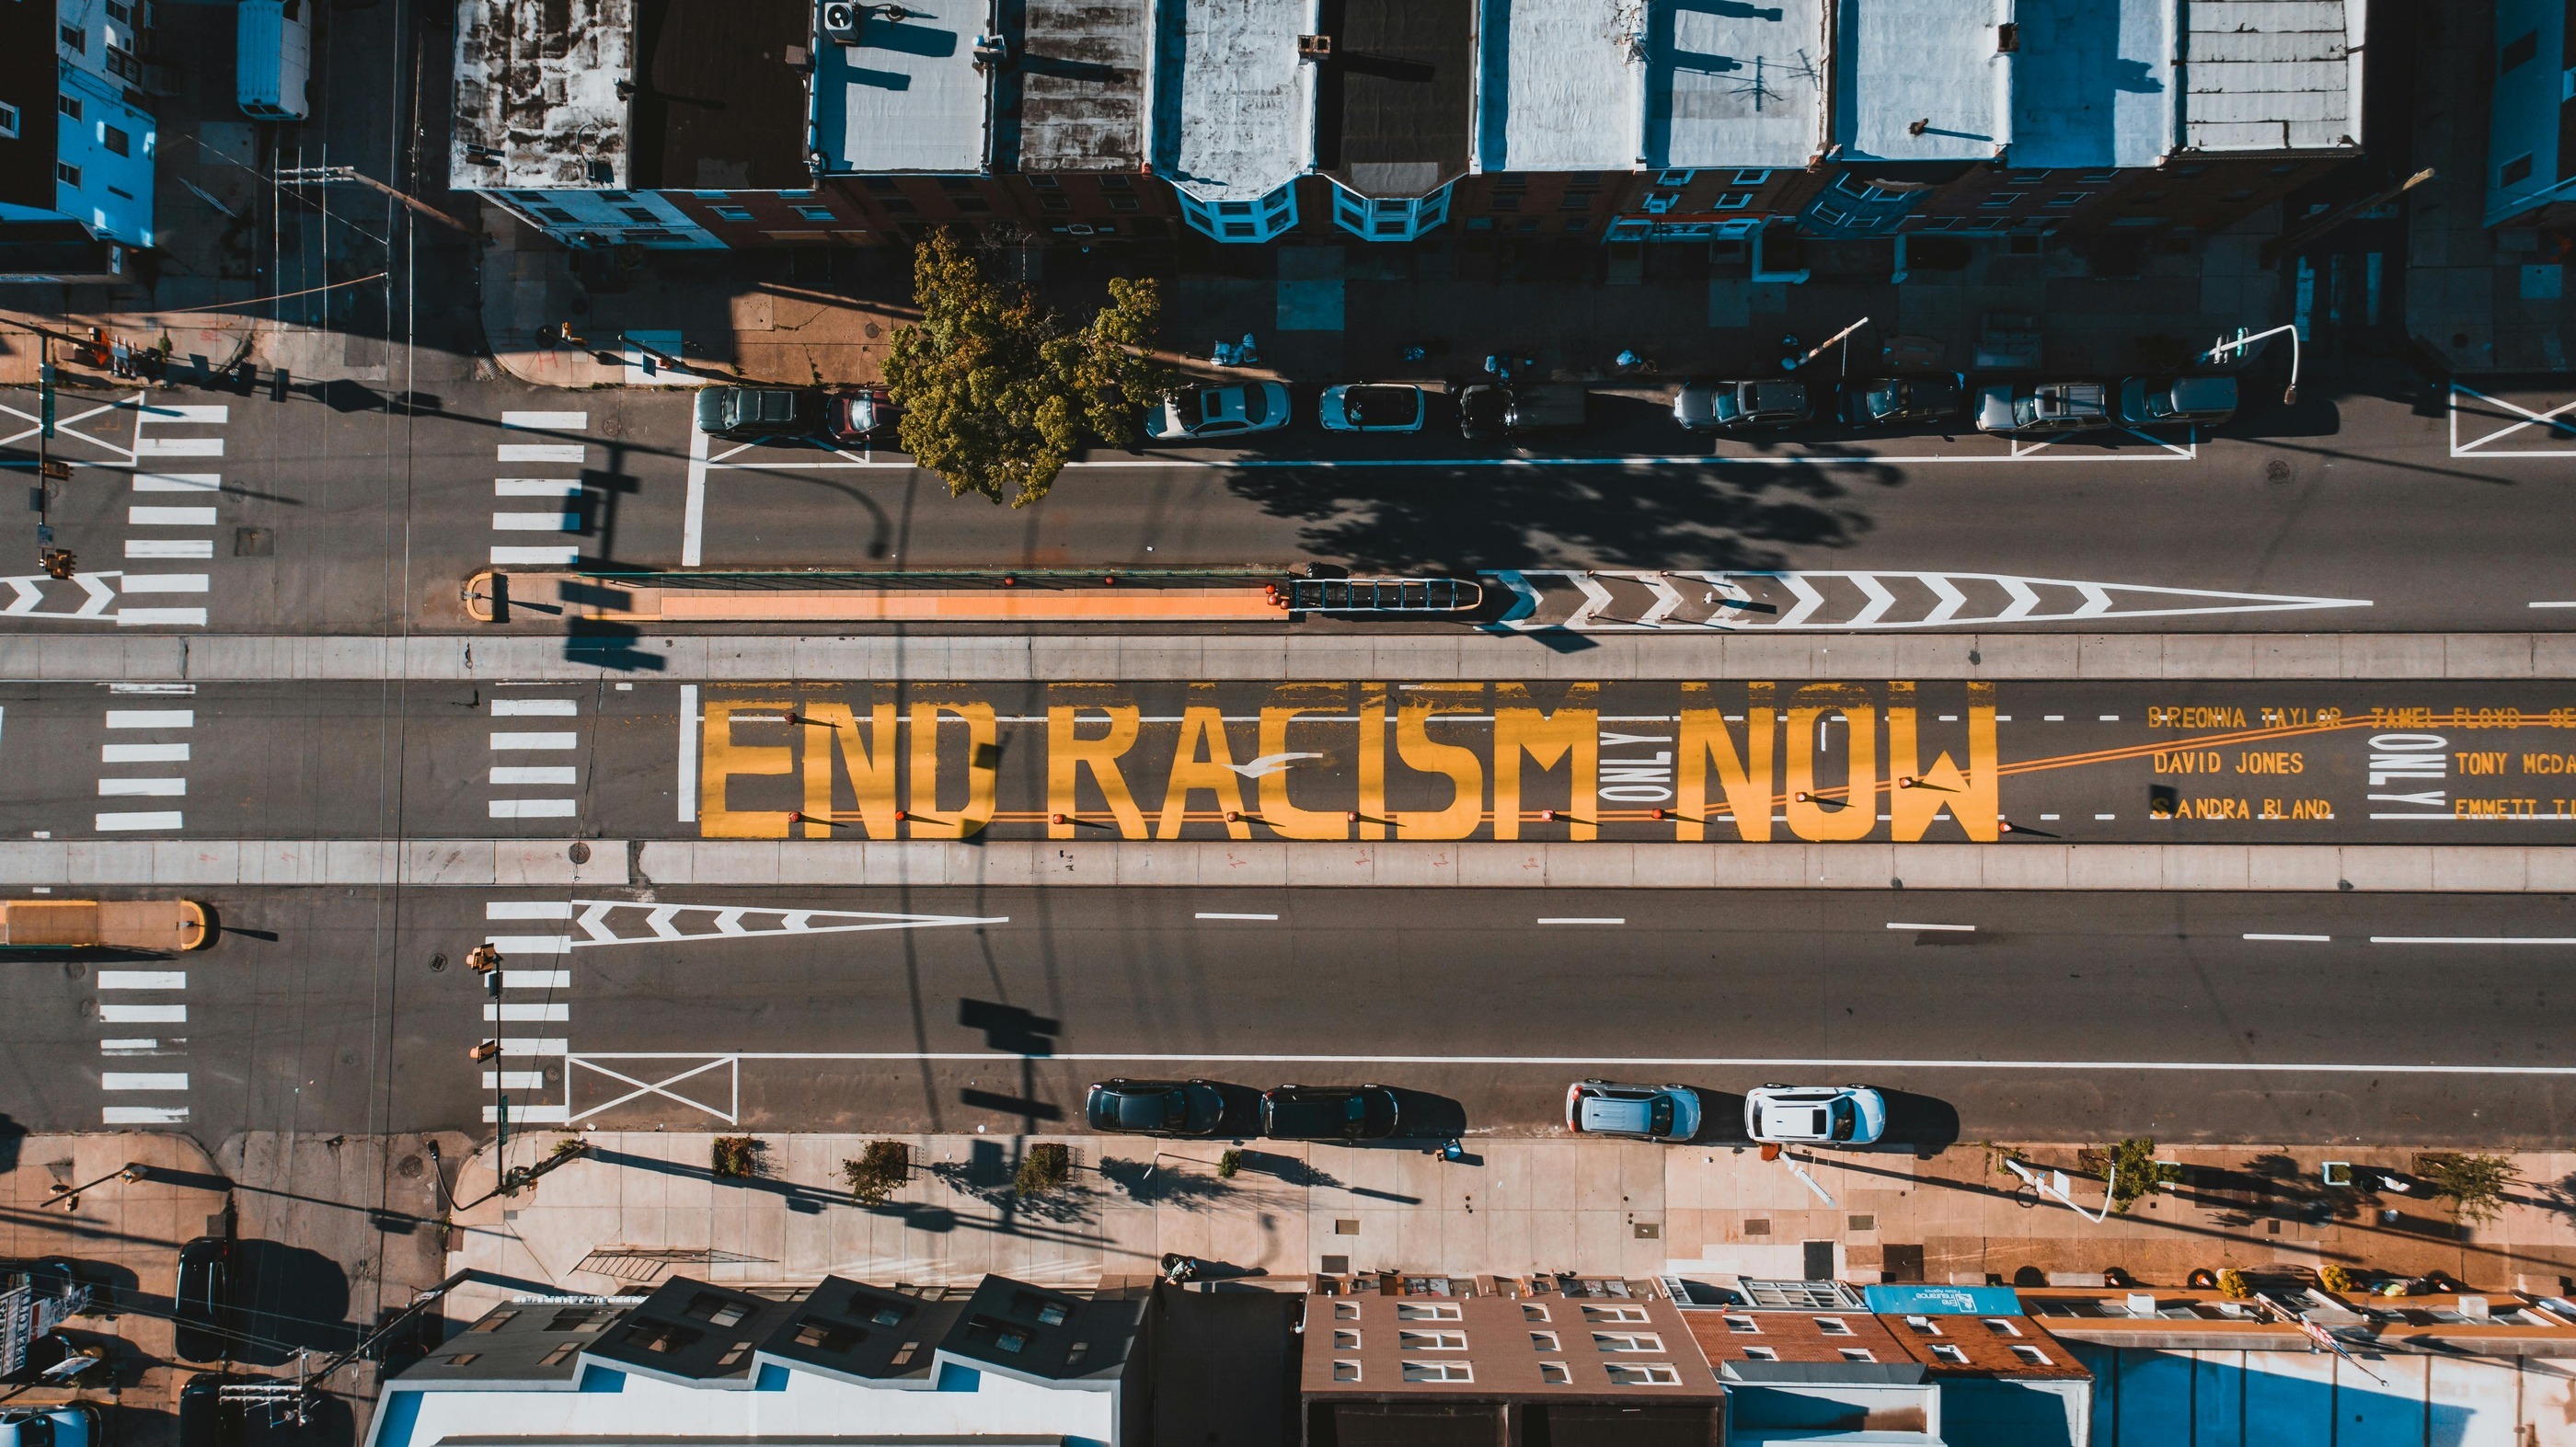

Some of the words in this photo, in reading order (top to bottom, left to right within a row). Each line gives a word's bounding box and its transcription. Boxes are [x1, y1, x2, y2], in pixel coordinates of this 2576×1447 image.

[2148, 706, 2247, 728] BREONNA
[2261, 706, 2342, 728] TAYLOR
[2371, 706, 2439, 729] JAMEL
[2454, 706, 2520, 729] FLOYD
[700, 683, 997, 839] END
[1046, 682, 1599, 840] RACISM
[1675, 682, 1999, 841] NOW
[1598, 731, 1673, 802] ONLY
[2154, 752, 2221, 775] DAVID
[2236, 752, 2304, 775] JONES
[2367, 734, 2448, 805] ONLY
[2455, 752, 2508, 775] TONY
[2523, 753, 2576, 775] MCDA
[2152, 797, 2250, 820] SANDRA
[2264, 798, 2331, 820] BLAND
[2455, 798, 2536, 820] EMMETT
[19, 1292, 30, 1325] CITY
[15, 1327, 28, 1369] BEER
